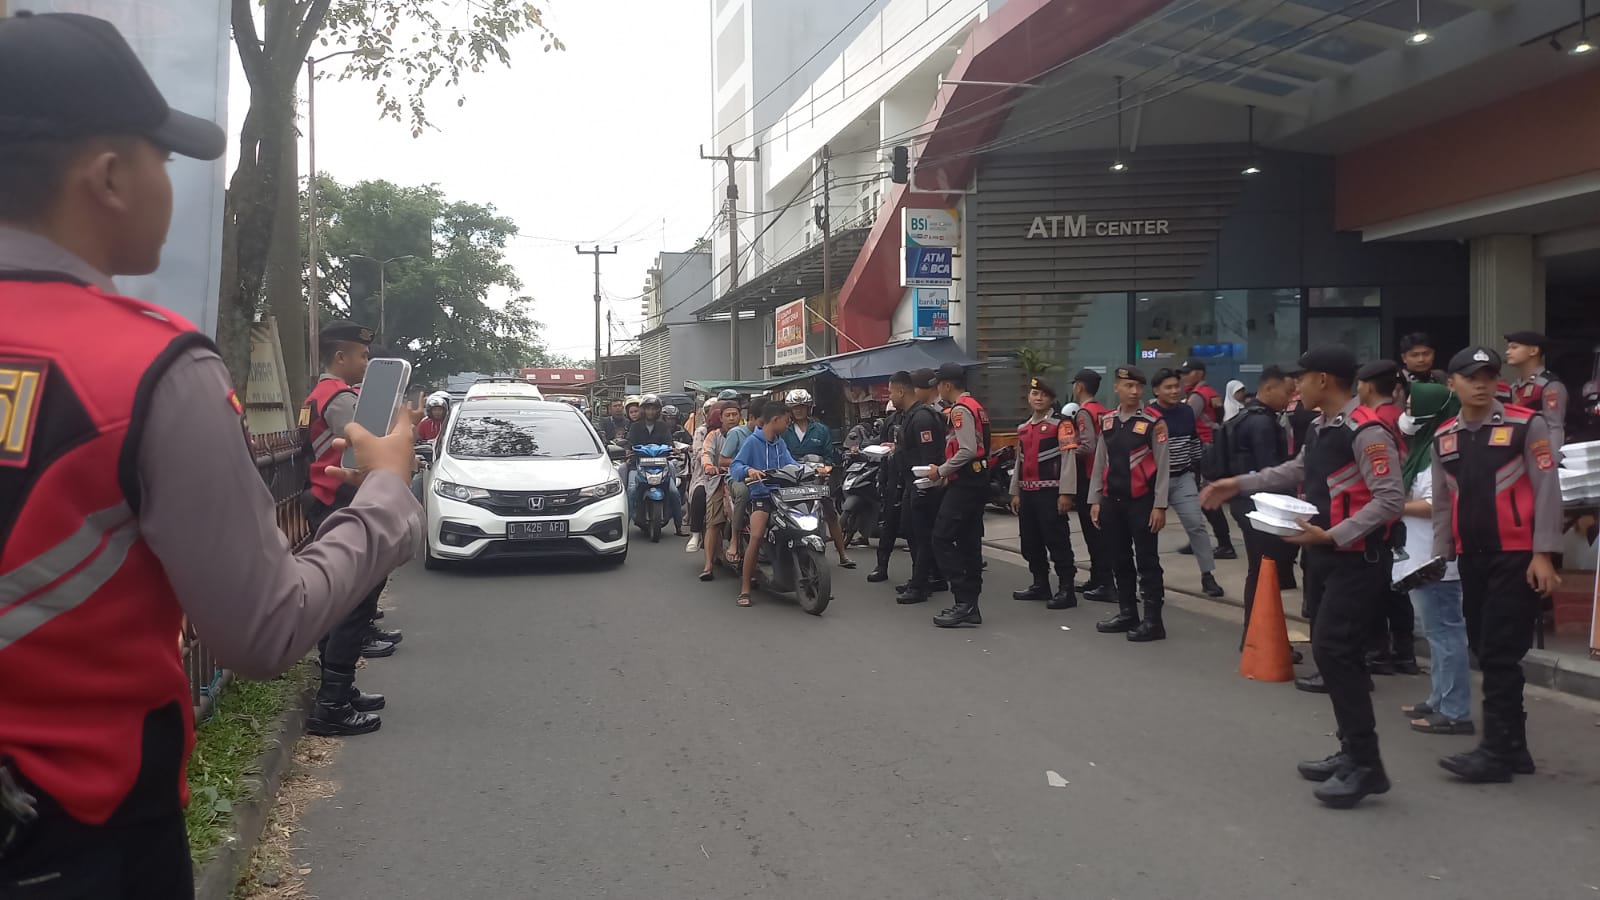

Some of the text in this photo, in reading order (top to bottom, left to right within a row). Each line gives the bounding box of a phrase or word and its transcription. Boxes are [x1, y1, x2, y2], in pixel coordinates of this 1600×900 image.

[911, 217, 928, 231] BSI
[1026, 214, 1169, 239] ATM CENTER
[923, 252, 946, 263] ATM
[930, 264, 950, 274] BCA
[935, 298, 947, 306] bjb
[1141, 349, 1157, 359] BSI
[523, 522, 543, 533] 1426
